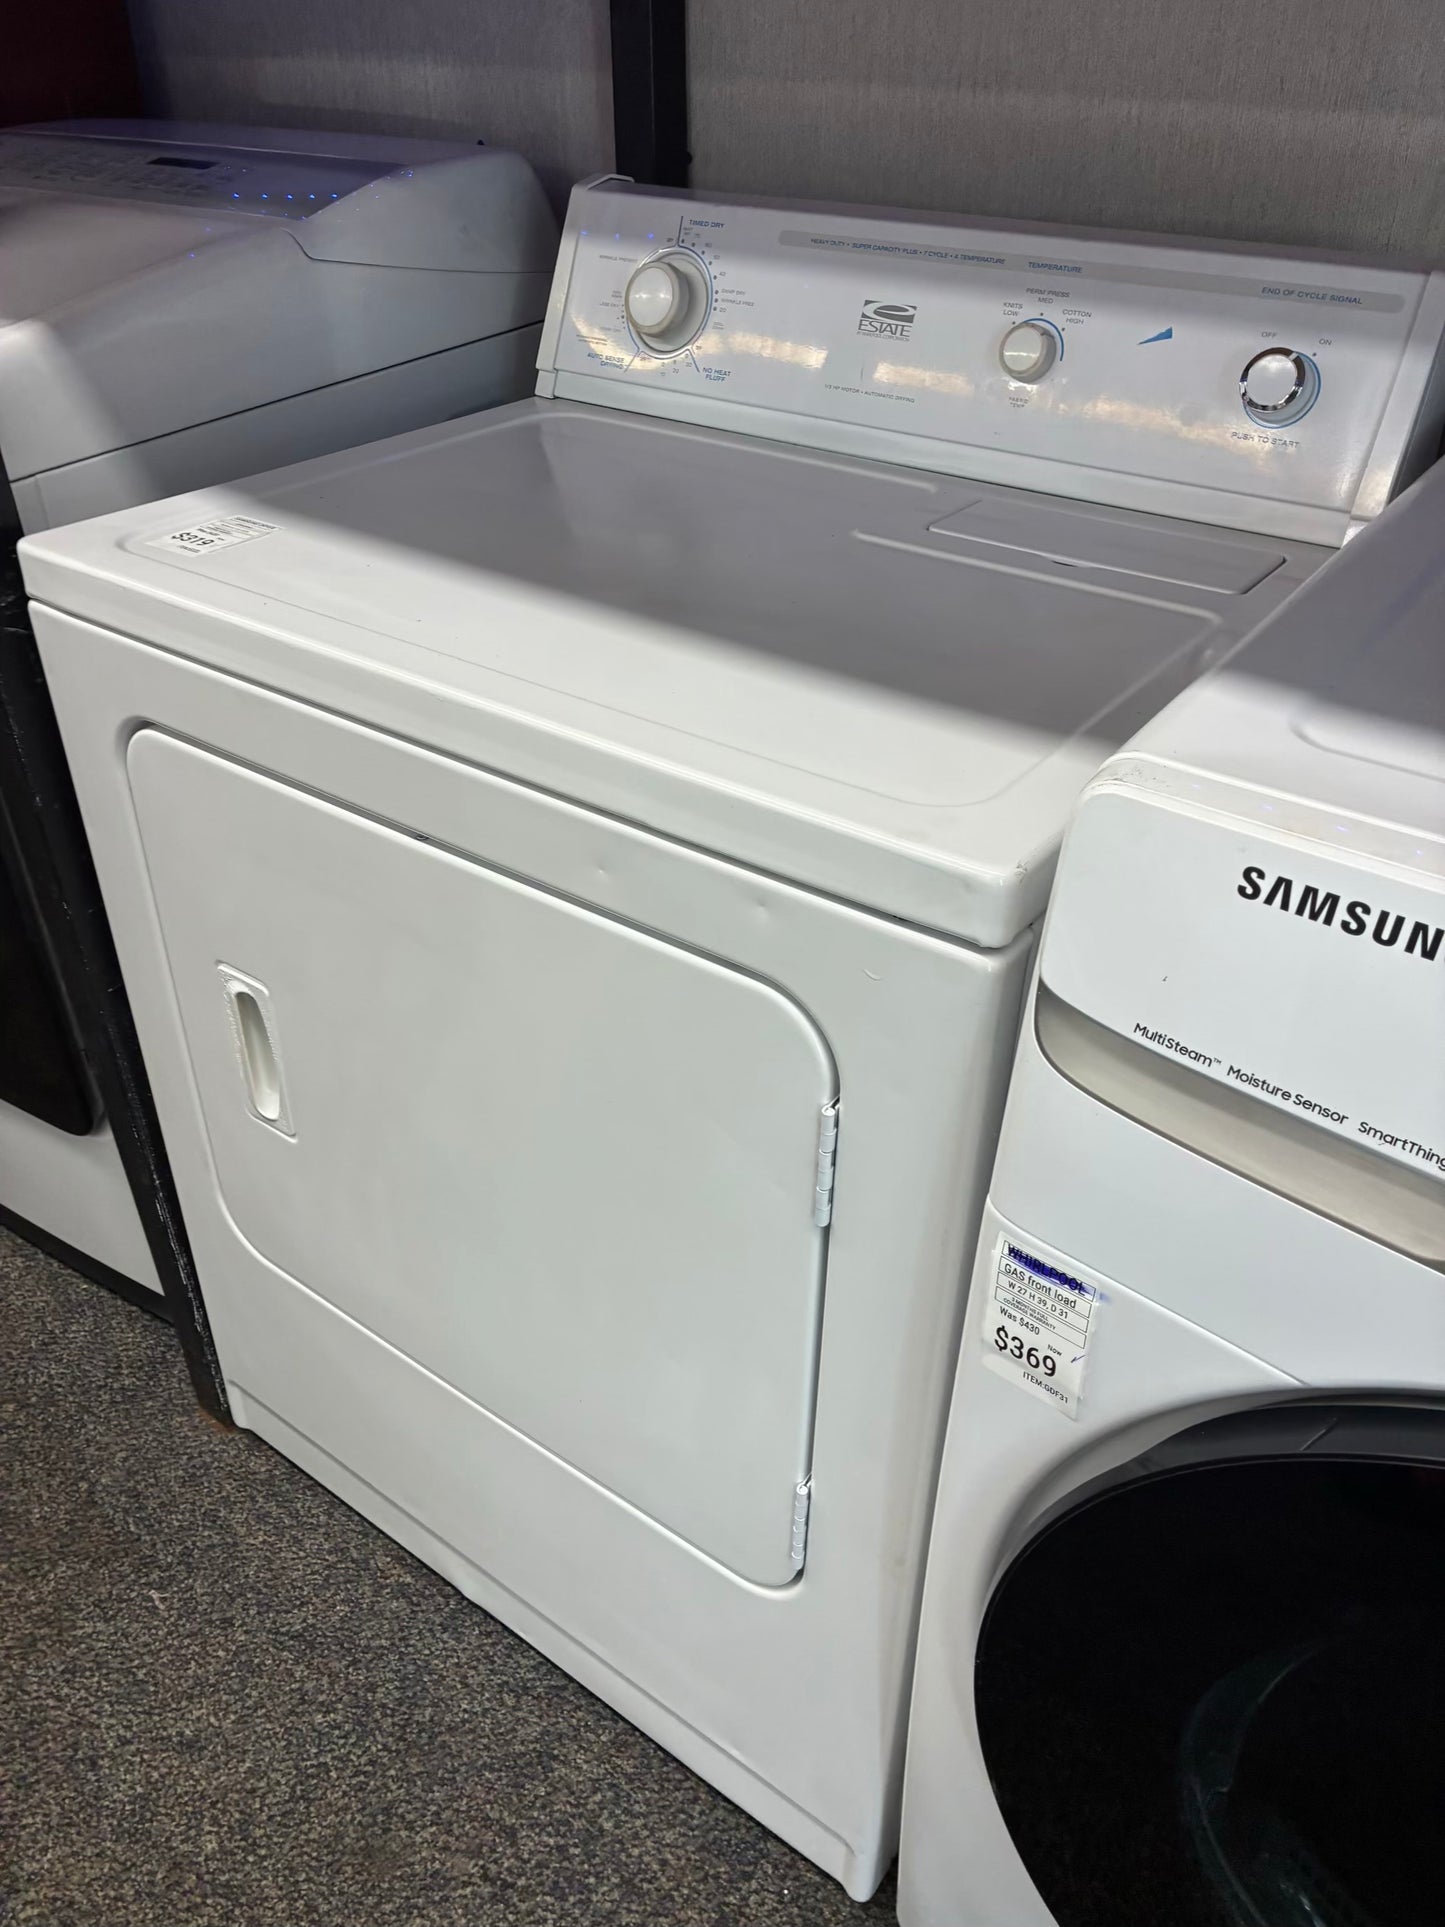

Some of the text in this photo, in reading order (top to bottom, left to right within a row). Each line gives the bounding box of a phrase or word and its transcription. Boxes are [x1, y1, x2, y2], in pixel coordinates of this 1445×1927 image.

[689, 219, 709, 227] TIMED
[872, 244, 901, 253] CAPACITY
[902, 247, 918, 255] PLUS
[928, 251, 948, 259] CYCLE
[959, 254, 1006, 265] TEMPERATURE
[1028, 261, 1083, 274] TEMPERATURE
[1026, 287, 1071, 298] PERM PRESS
[1261, 286, 1363, 305] END OF CYCLE SIGNAL
[1003, 302, 1023, 310] KNITS
[1062, 308, 1092, 318] COTTON
[858, 319, 913, 338] ESTATE
[1066, 317, 1085, 325] HIGH
[1261, 331, 1278, 339] OFF
[1318, 338, 1332, 346] ON
[714, 369, 731, 377] HEAT
[1231, 431, 1300, 448] PUSH TO START
[1237, 866, 1445, 962] SAMSUN
[1226, 1064, 1292, 1101] Moisture
[1292, 1093, 1349, 1125] Sensor
[1004, 1263, 1077, 1309] GAS front load
[1008, 1280, 1069, 1320] W 27 H 39, D 31
[999, 1305, 1040, 1336] Was $430
[994, 1325, 1056, 1377] $369
[1047, 1343, 1062, 1357] Now
